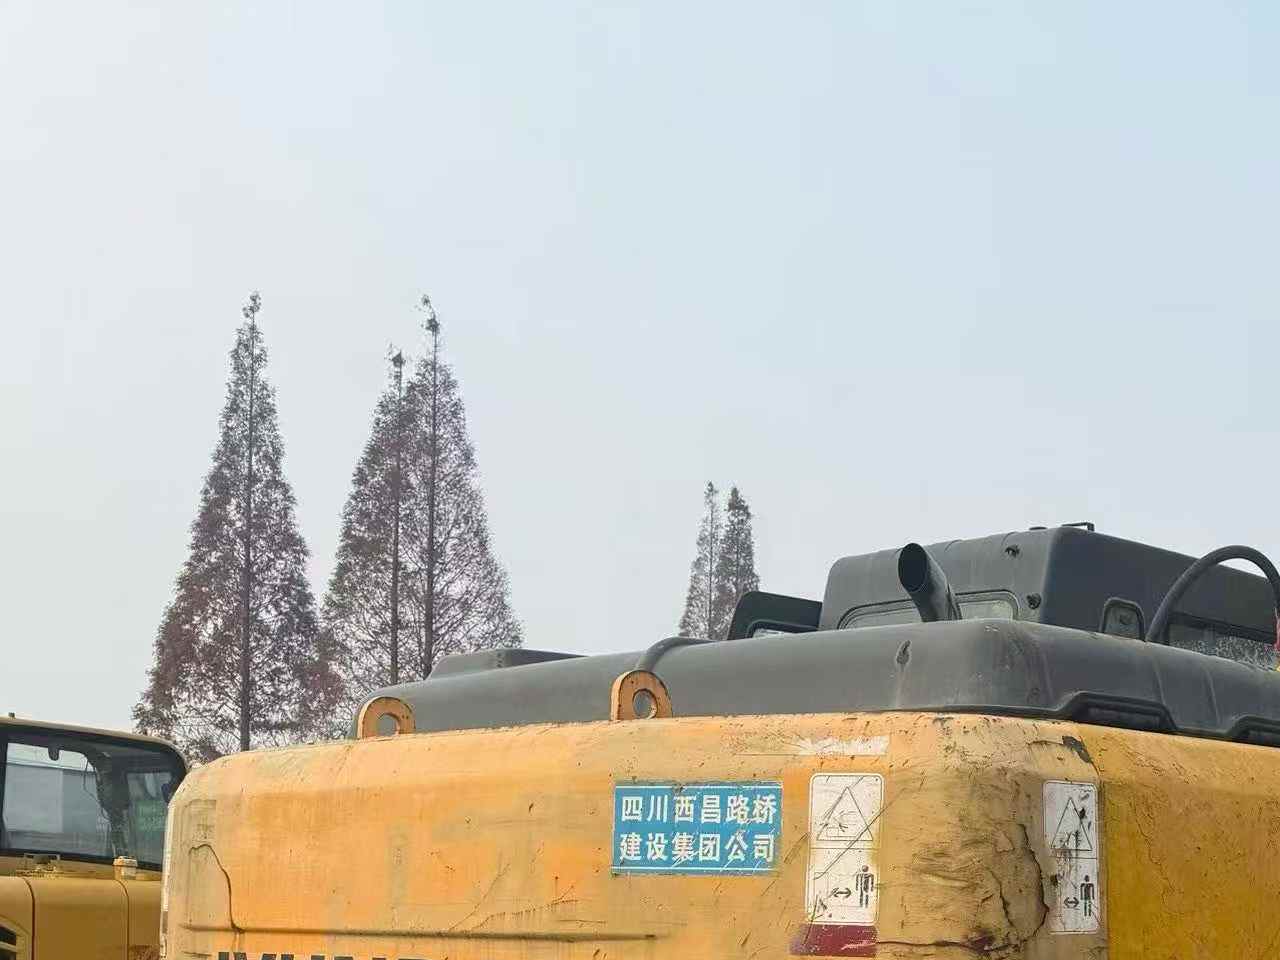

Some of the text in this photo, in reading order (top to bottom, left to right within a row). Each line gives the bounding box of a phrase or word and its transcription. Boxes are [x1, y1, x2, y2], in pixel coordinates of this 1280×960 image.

[621, 795, 777, 824] 四川西昌路桥
[619, 832, 775, 862] 建设集团公司
